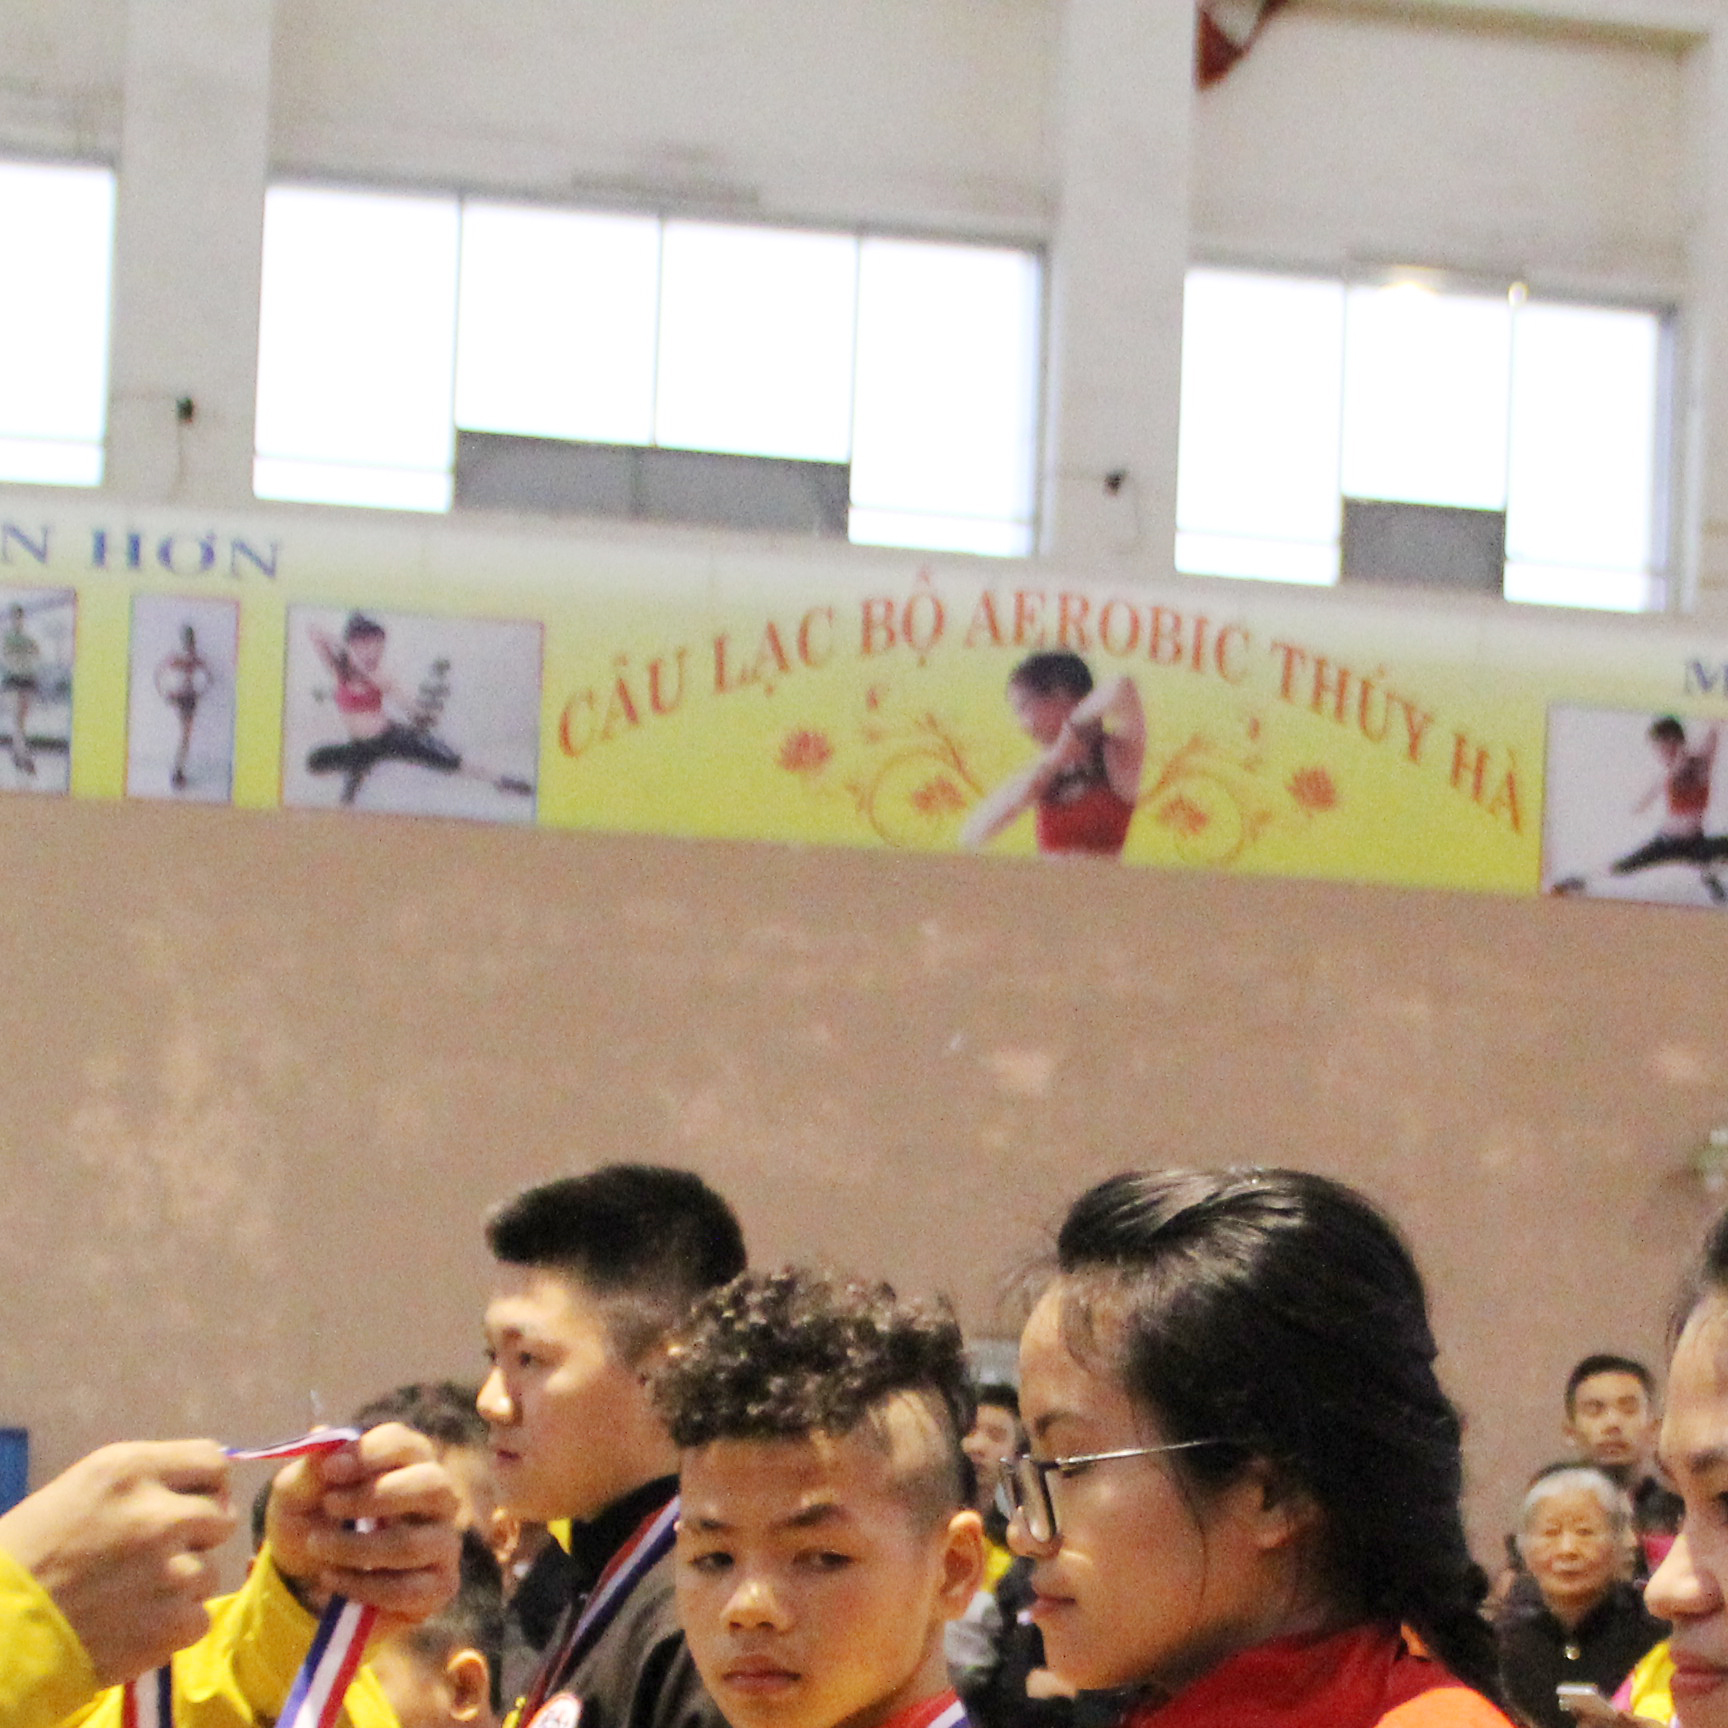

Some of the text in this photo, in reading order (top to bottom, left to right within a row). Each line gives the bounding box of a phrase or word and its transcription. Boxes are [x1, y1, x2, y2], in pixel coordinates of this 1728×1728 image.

[90, 528, 282, 580] HƠN
[714, 606, 834, 696] LẠC
[860, 569, 945, 667] BỘ
[965, 590, 1250, 686] AEROBIC
[1450, 731, 1523, 834] HÀ
